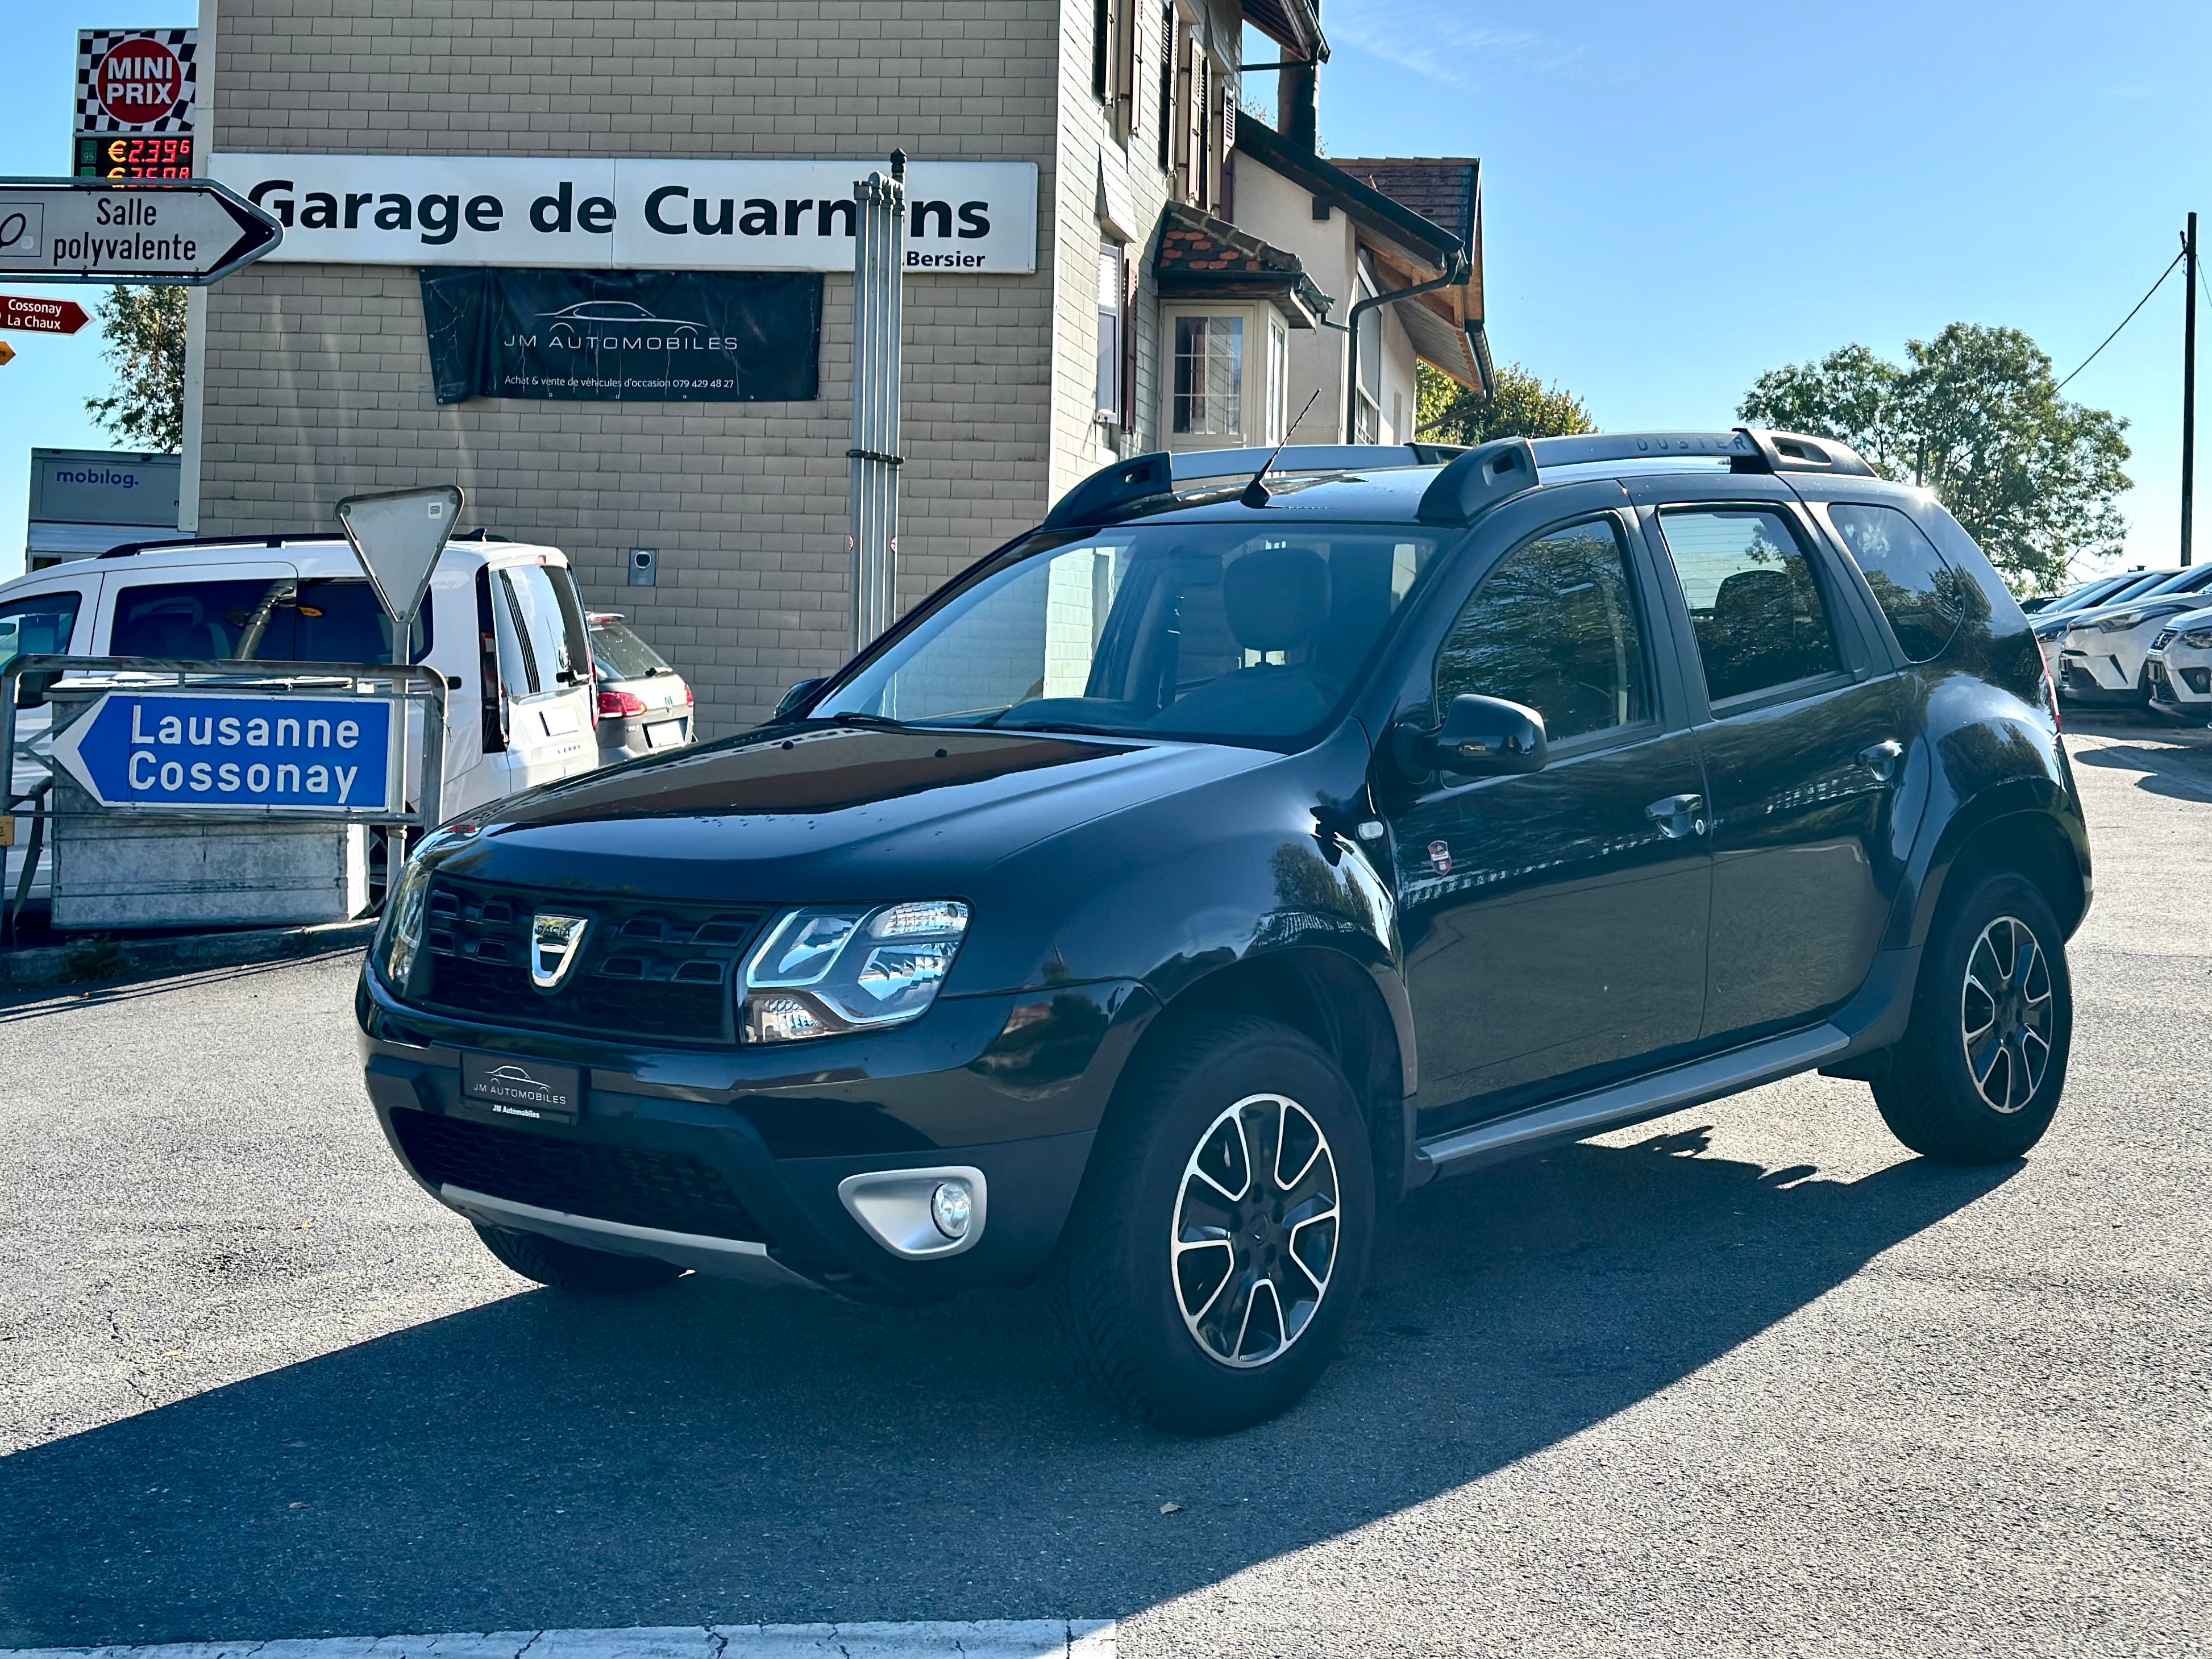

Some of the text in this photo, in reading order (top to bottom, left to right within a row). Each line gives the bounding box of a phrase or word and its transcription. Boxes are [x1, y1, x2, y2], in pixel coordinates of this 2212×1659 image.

[107, 57, 173, 80] MINI
[106, 83, 173, 105] PRIX
[97, 197, 157, 226] Salle
[247, 180, 991, 246] Garage de Cuarnns
[53, 232, 197, 267] polyvalente
[8, 299, 62, 317] Cossonay
[7, 314, 61, 330] La Chaux
[504, 335, 738, 350] JM AUTOMOBILES
[505, 375, 530, 385] Achat
[531, 376, 539, 385] &
[541, 377, 566, 386] vente
[567, 377, 579, 386] de
[581, 377, 622, 387] véhicules
[624, 378, 671, 388] d'occasion
[710, 379, 721, 388] 48
[724, 380, 734, 388] 27
[1635, 437, 1747, 451] DUSTER
[131, 704, 359, 748] Lausanne
[129, 750, 357, 804] Cossonay
[537, 925, 570, 938] DACIA
[473, 1084, 566, 1105] JM AUTOMOBILES
[502, 1106, 540, 1119] Automobiles
